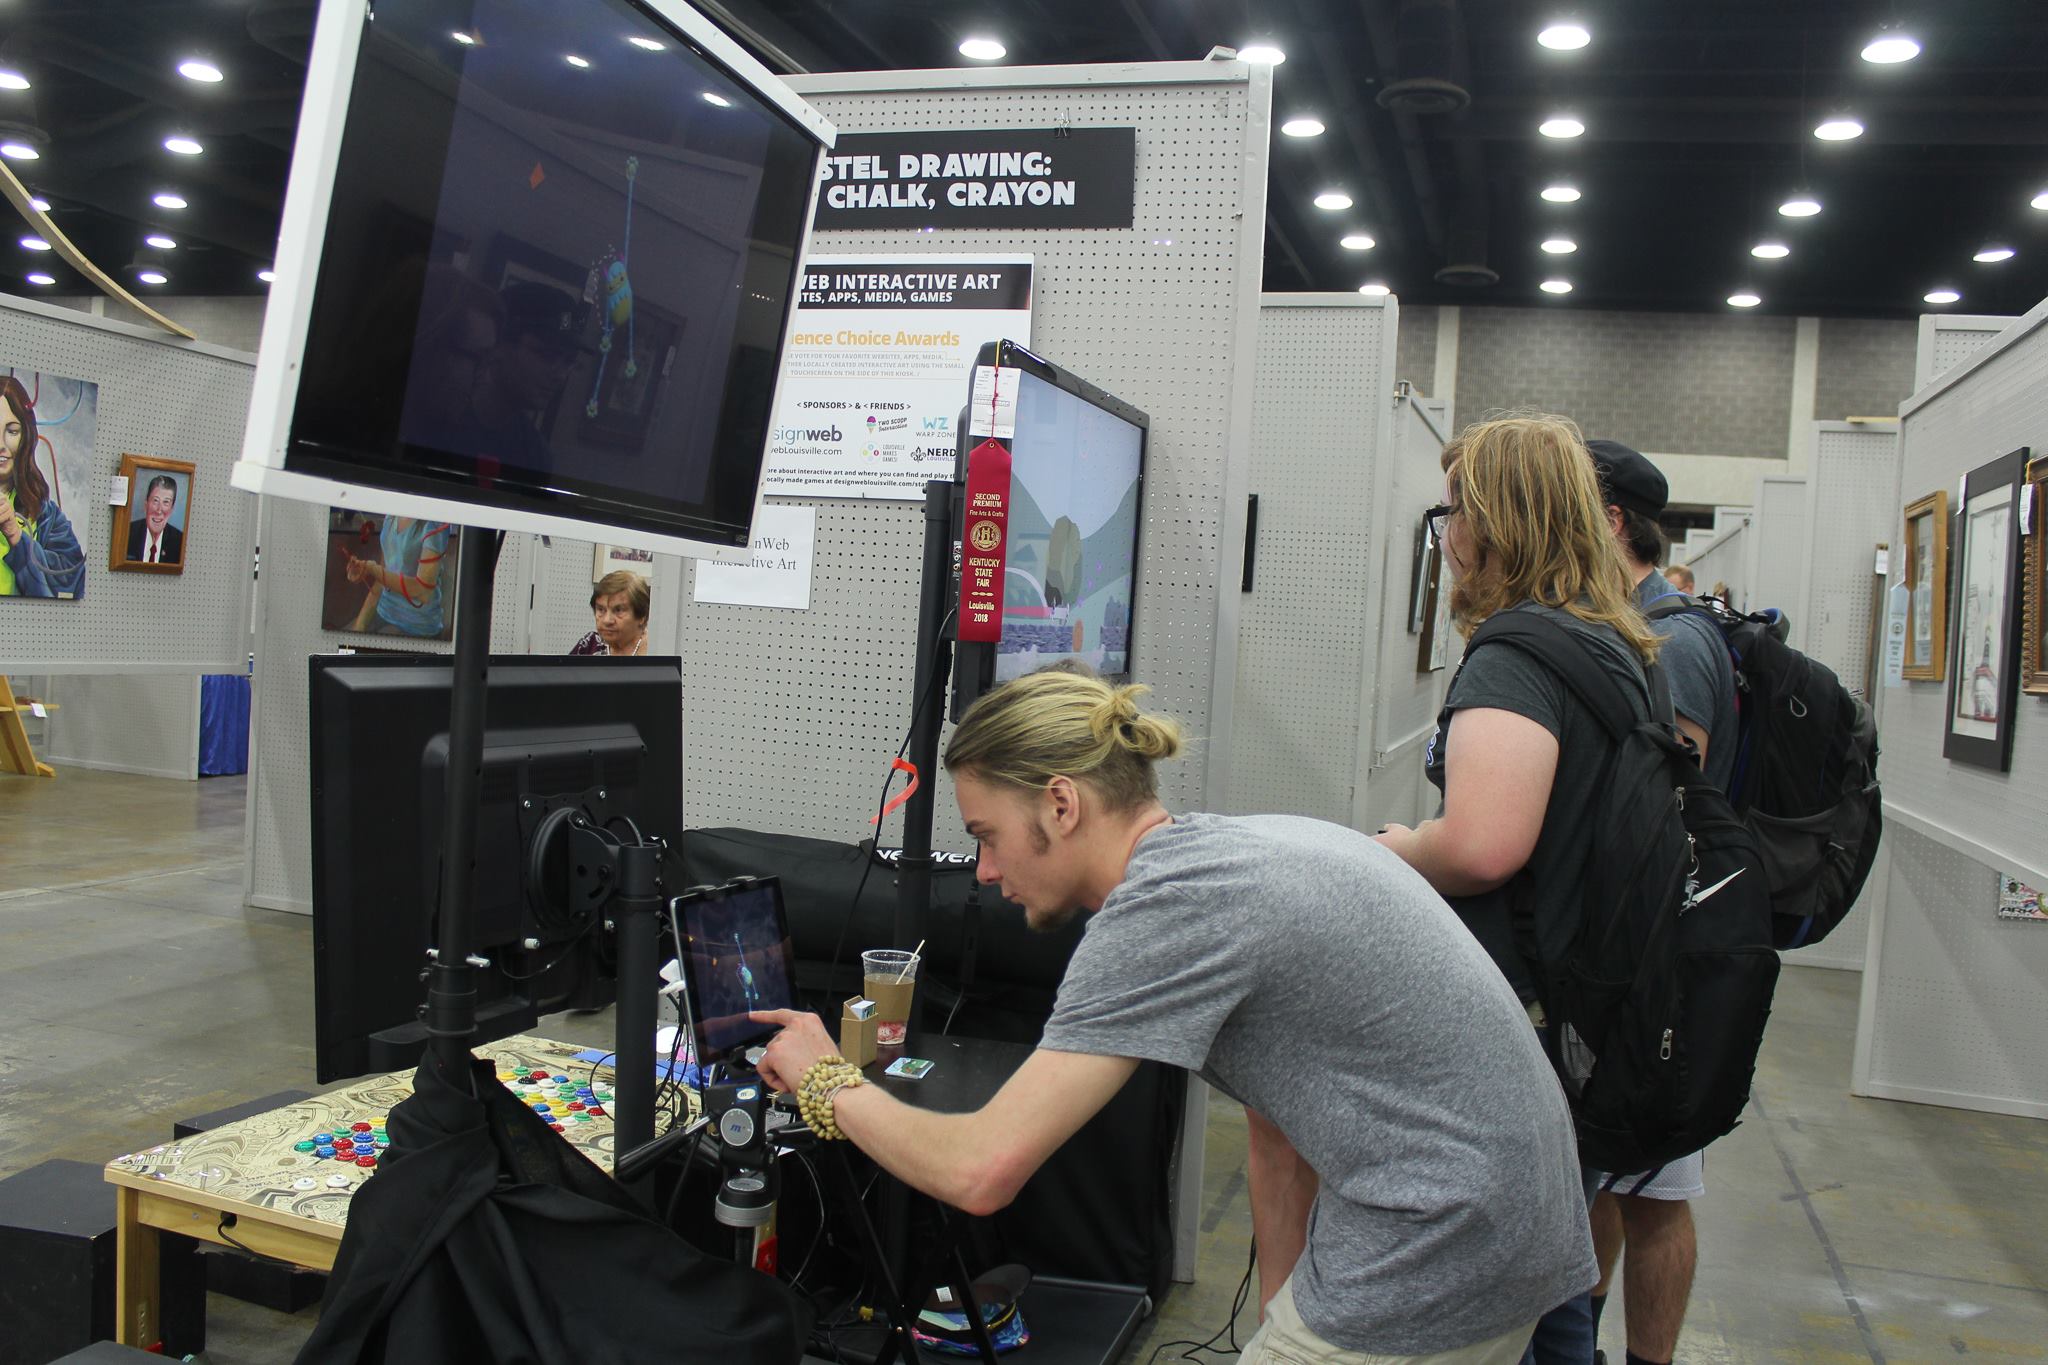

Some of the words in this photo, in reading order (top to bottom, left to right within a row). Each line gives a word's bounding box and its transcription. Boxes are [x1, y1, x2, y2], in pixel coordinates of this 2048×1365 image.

[820, 155, 889, 181] STEL
[899, 152, 1052, 178] DRAWING:
[827, 183, 936, 210] CHALK,
[946, 181, 1075, 207] CRAYON
[836, 273, 957, 290] INTERACTIVE
[962, 273, 1002, 290] ART
[828, 291, 861, 304] APPS,
[864, 291, 907, 304] MEDIA,
[910, 291, 953, 303] GAMES
[836, 330, 891, 346] Choice
[894, 330, 960, 347] Awards
[803, 401, 847, 410] SPONSORS
[870, 402, 905, 410] FRIENDS
[922, 416, 949, 430] WZ
[927, 448, 957, 457] NERD
[934, 472, 948, 480] play
[974, 492, 1001, 501] SECOND
[972, 500, 1002, 508] PREMIUM
[777, 557, 797, 570] Art
[968, 557, 1001, 568] KENTUCKY
[974, 568, 993, 578] STATE
[976, 578, 990, 588] FAIR
[968, 600, 995, 611] Louisville
[973, 613, 989, 623] 2018
